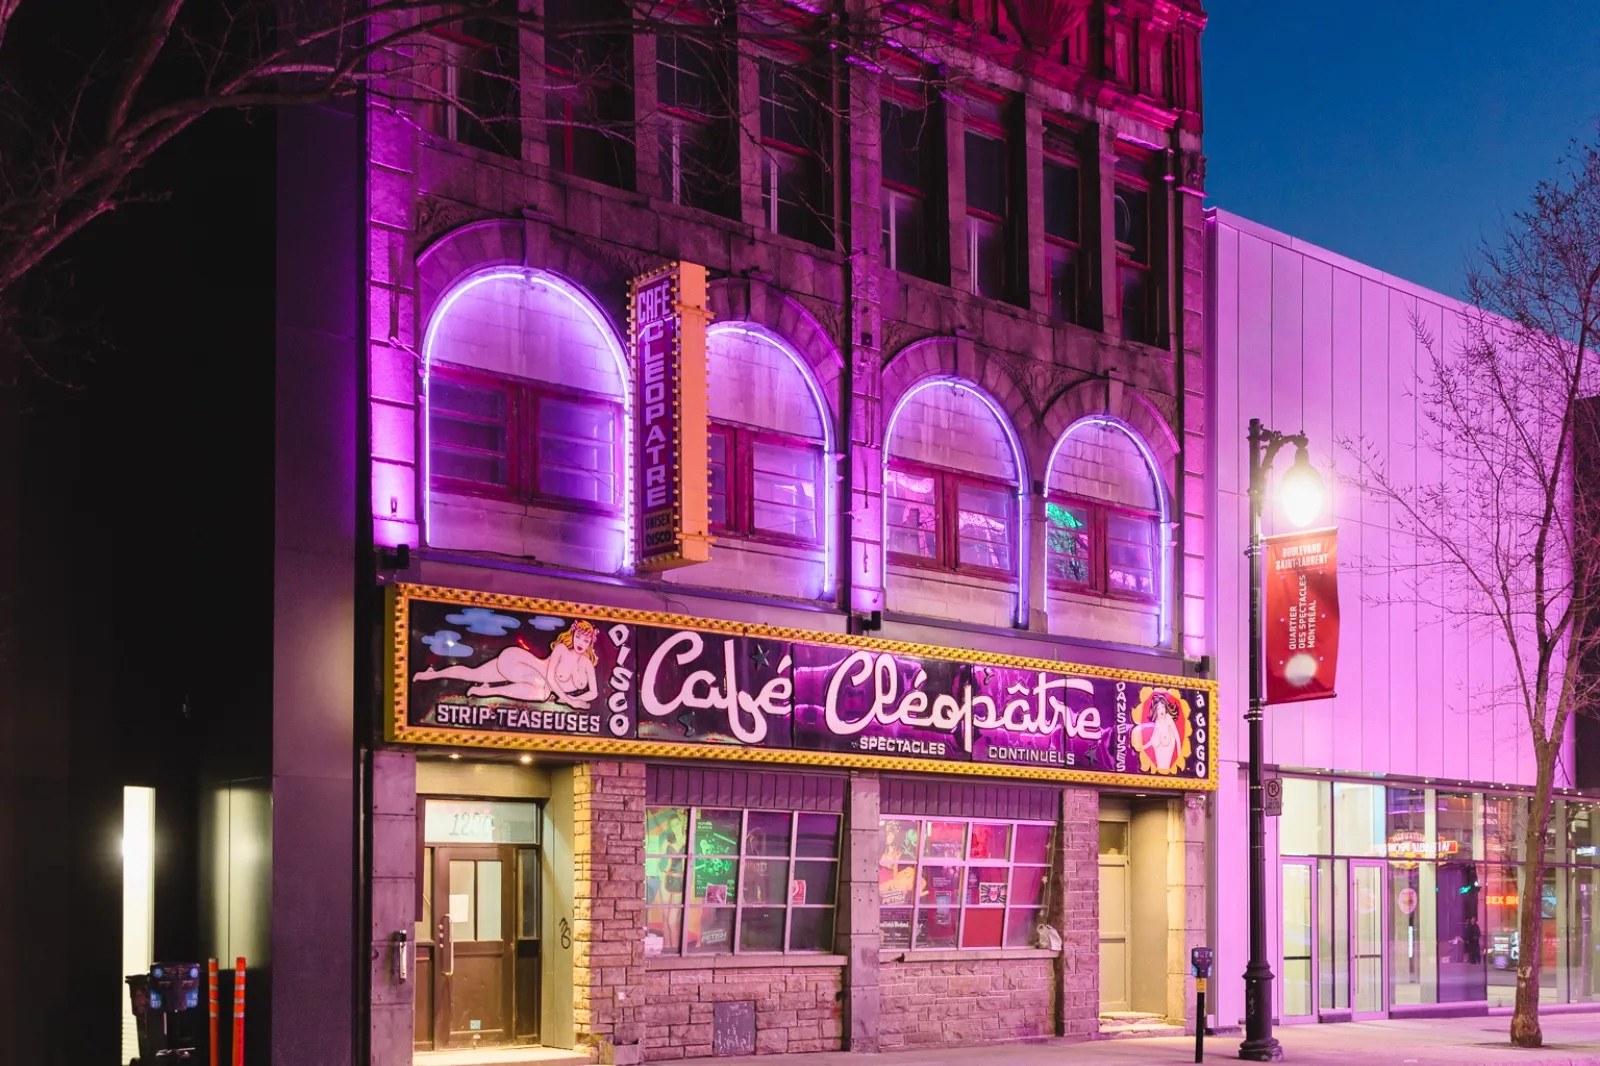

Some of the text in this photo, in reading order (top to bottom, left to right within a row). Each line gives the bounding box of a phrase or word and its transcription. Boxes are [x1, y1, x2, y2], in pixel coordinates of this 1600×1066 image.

[638, 281, 670, 324] CAFÉ
[645, 320, 667, 507] CLEOPATRE
[645, 512, 671, 530] UNISEX
[646, 529, 672, 547] DISCO
[1275, 553, 1328, 570] SAINT-LAURENT
[1282, 543, 1322, 558] BOULEVARD
[1289, 606, 1297, 650] QUARTIER
[1298, 574, 1307, 649] DES SPECTACLES
[1306, 600, 1316, 648] MONTRÉAL
[608, 624, 633, 737] DISCO
[641, 631, 1101, 752] Café Cléopâtre
[437, 704, 600, 732] STRIP-TEASEUSES
[1116, 681, 1126, 772] DANSEUSES
[860, 737, 946, 755] SPECTACLES
[988, 746, 1075, 765] CONTINUELS
